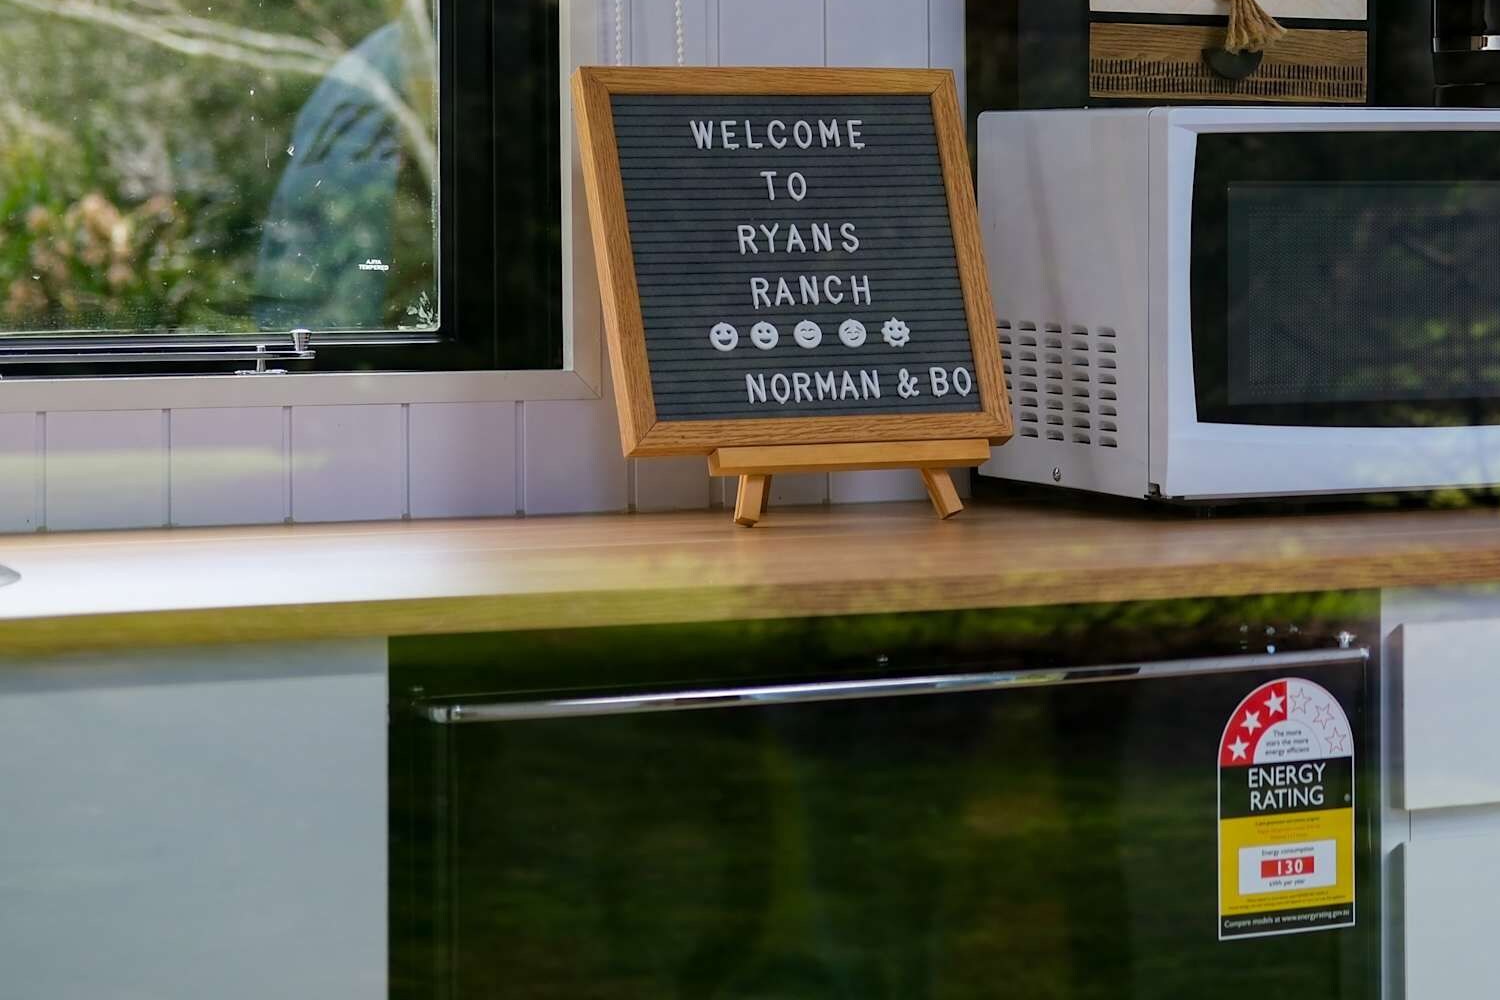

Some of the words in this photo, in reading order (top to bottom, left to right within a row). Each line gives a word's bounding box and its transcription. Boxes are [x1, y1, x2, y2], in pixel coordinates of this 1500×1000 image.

[690, 118, 866, 150] WELCOME
[760, 171, 807, 201] TO
[737, 222, 860, 255] RYANS
[751, 275, 871, 309] RANCH
[745, 369, 881, 404] NORMAN
[897, 368, 920, 399] &
[929, 366, 972, 398] BO
[1248, 762, 1327, 789] ENERGY
[1250, 785, 1325, 812] RATING
[1261, 848, 1279, 857] Energy
[1281, 846, 1315, 855] consumption
[1277, 858, 1304, 876] 130
[1224, 917, 1251, 929] Compare
